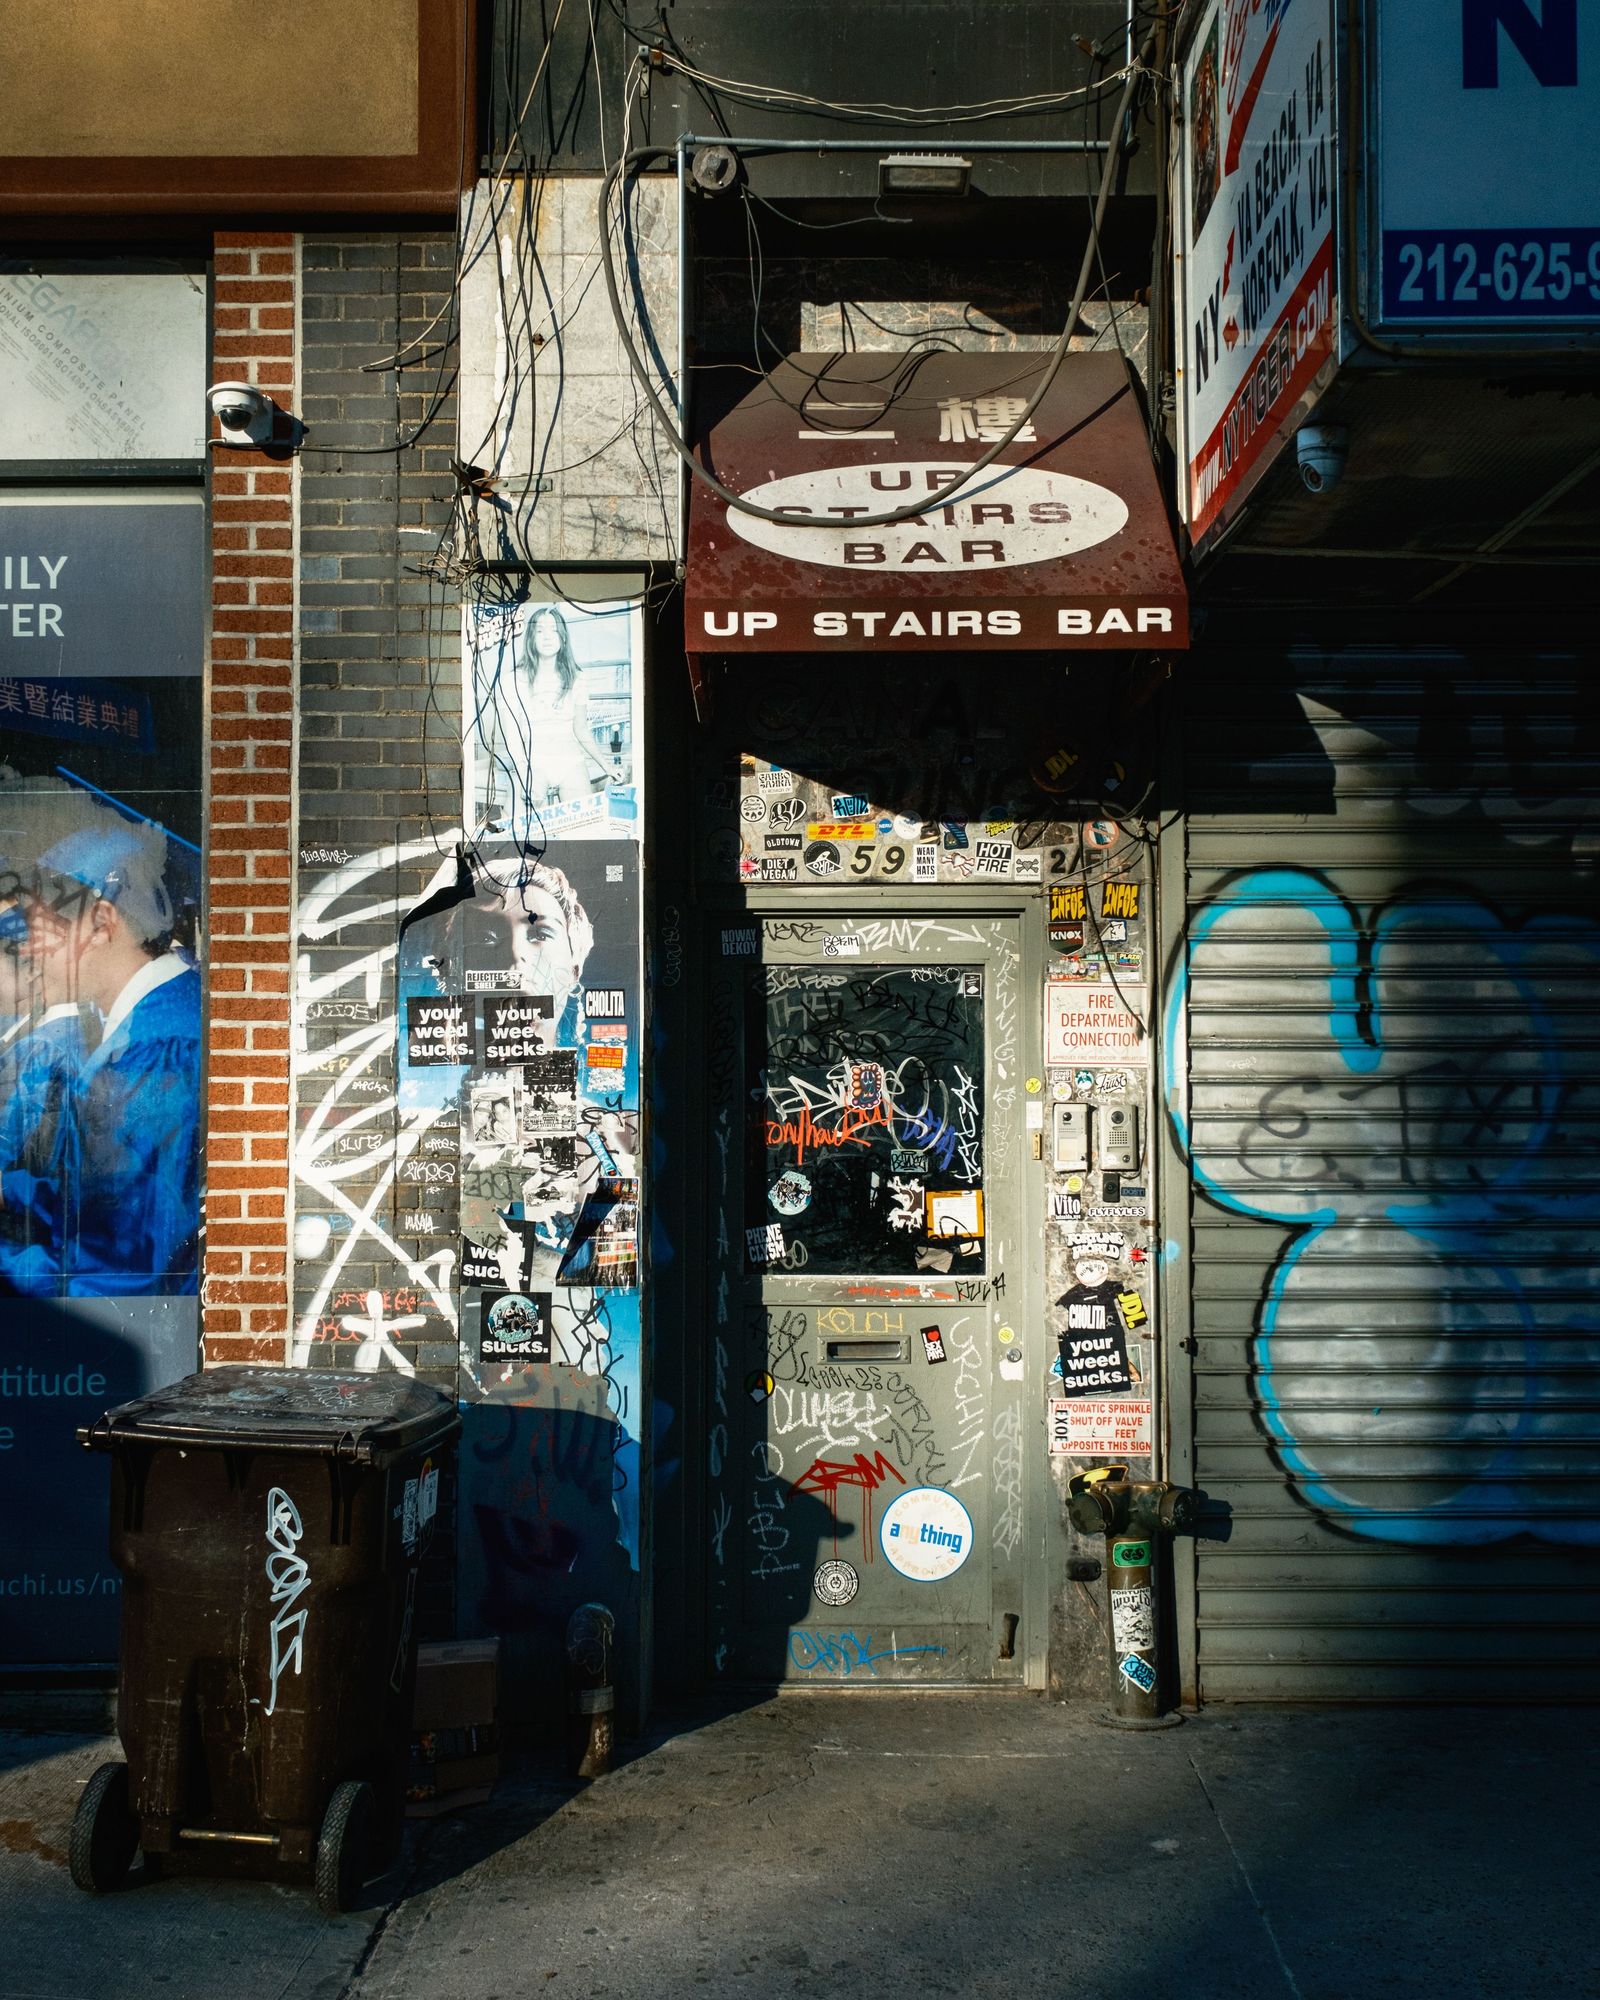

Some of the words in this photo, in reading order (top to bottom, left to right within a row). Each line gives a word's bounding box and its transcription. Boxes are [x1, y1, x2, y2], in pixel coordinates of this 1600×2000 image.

[1463, 0, 1578, 89] N
[1237, 181, 1253, 263] VA
[1306, 39, 1324, 137] VA
[1309, 134, 1328, 232] VA
[1195, 276, 1221, 396] NY
[870, 468, 967, 491] UP
[843, 540, 1006, 564] BAR
[4, 556, 69, 590] ILY
[703, 611, 778, 637] UP
[812, 610, 1022, 637] STAIRS
[1056, 607, 1174, 636] BAR
[818, 825, 865, 835] DTL
[766, 838, 800, 848] OLDTOWN
[979, 842, 1009, 857] HOT
[916, 847, 935, 856] WEAR
[766, 859, 789, 870] DIET
[850, 845, 905, 875] 59
[916, 856, 935, 865] MANY
[976, 858, 1009, 873] FIRE
[762, 869, 797, 880] VEGAN
[916, 865, 935, 876] HATS
[721, 928, 757, 943] NOWAY
[1050, 930, 1082, 940] KNOX
[722, 942, 758, 956] DEKOY
[466, 972, 503, 982] REJECTED
[473, 981, 497, 990] SHELF
[585, 990, 625, 1017] CHOLITA
[1088, 994, 1115, 1009] FIRE
[419, 1006, 463, 1022] your
[495, 1007, 541, 1024] your
[1061, 1012, 1141, 1028] DEPARTMENT
[414, 1022, 468, 1039] weed
[491, 1024, 538, 1040] wee
[1062, 1032, 1140, 1047] CONNECTION
[410, 1043, 474, 1057] sucks.
[1068, 1303, 1106, 1330] CHOLITA
[1117, 1290, 1149, 1330] JDI.
[924, 1340, 942, 1352] SEX
[1069, 1336, 1114, 1356] your
[1067, 1350, 1121, 1371] weed
[1064, 1371, 1129, 1390] sucks.
[1070, 1417, 1093, 1426] SHUT
[1095, 1417, 1113, 1426] OFF
[1115, 1417, 1143, 1426] VALVE
[1115, 1429, 1137, 1438] FEET
[1108, 1441, 1127, 1450] THIS
